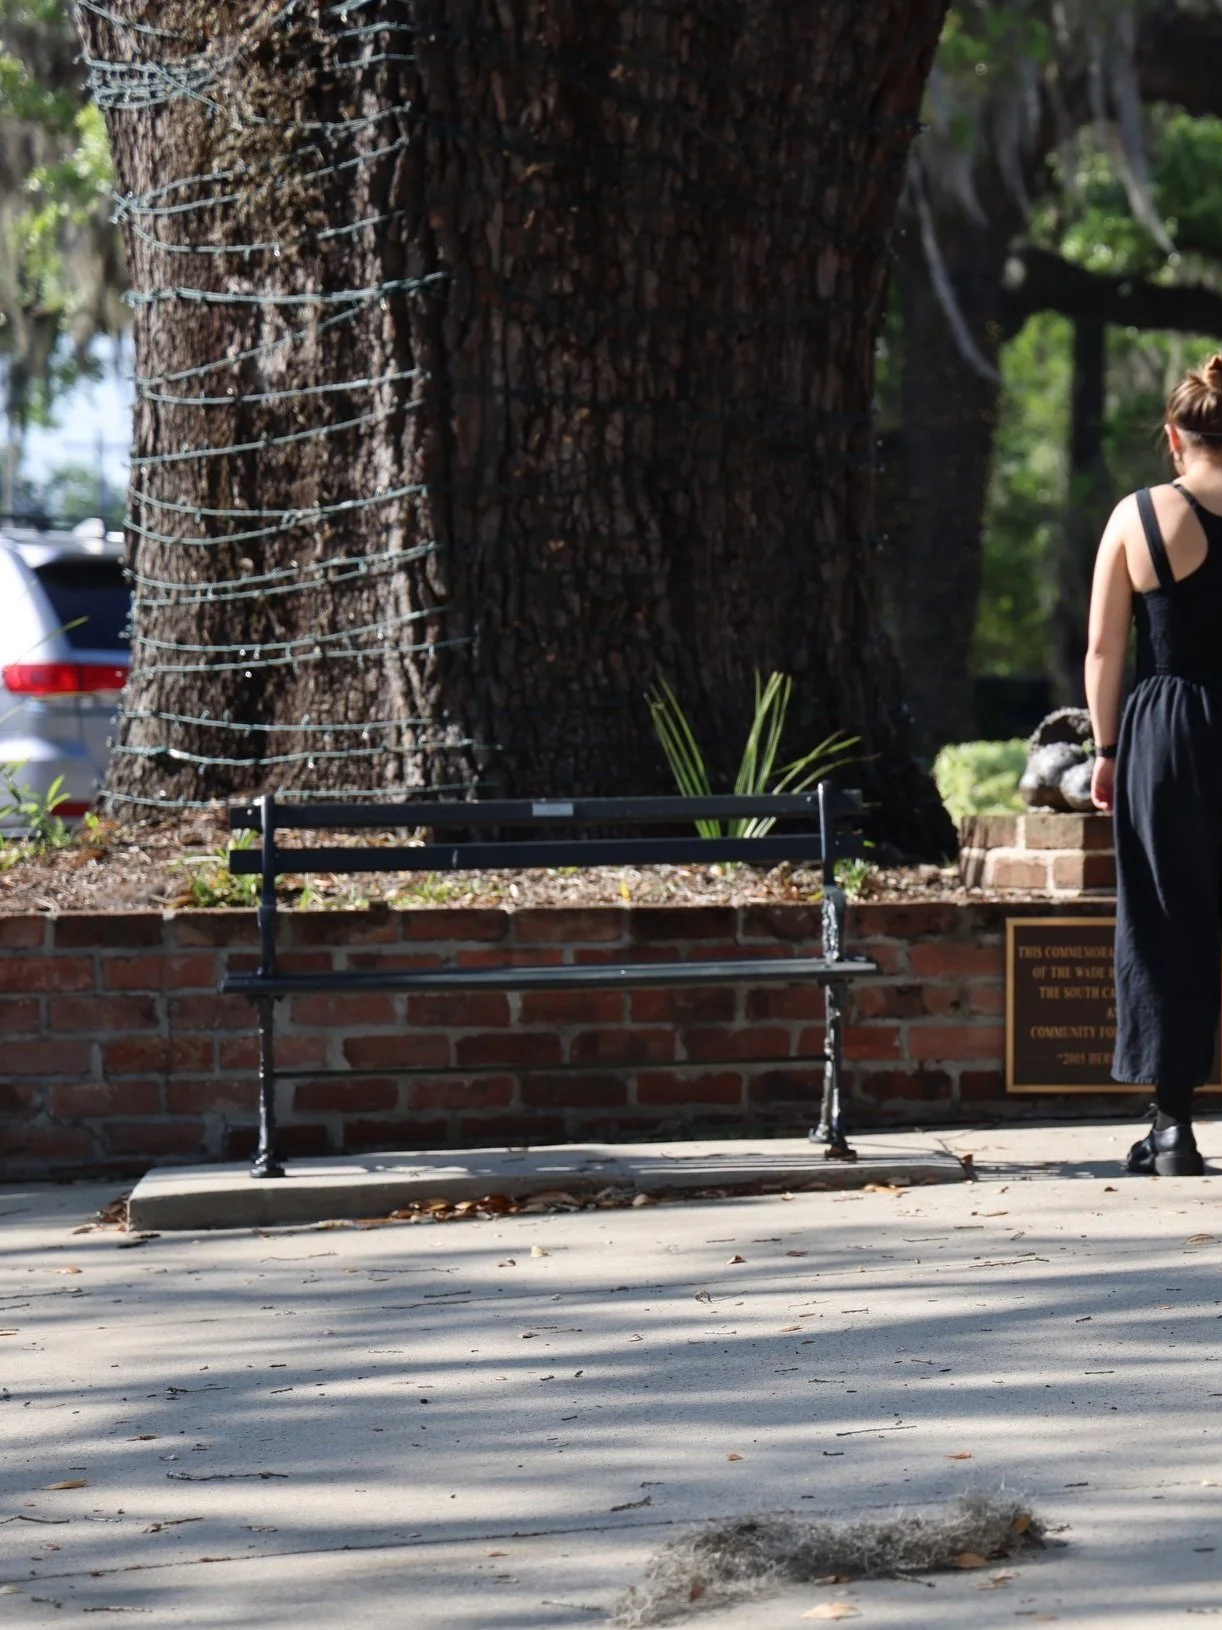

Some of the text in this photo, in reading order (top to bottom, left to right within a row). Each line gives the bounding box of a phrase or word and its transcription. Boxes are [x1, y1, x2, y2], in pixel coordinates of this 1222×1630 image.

[1018, 946, 1114, 959] THIS COMMEMORA
[1032, 966, 1047, 979] OF
[1051, 966, 1070, 979] THE
[1040, 986, 1060, 999] THE
[1063, 986, 1099, 999] SOUTH
[1030, 1026, 1095, 1039] COMMUNITY
